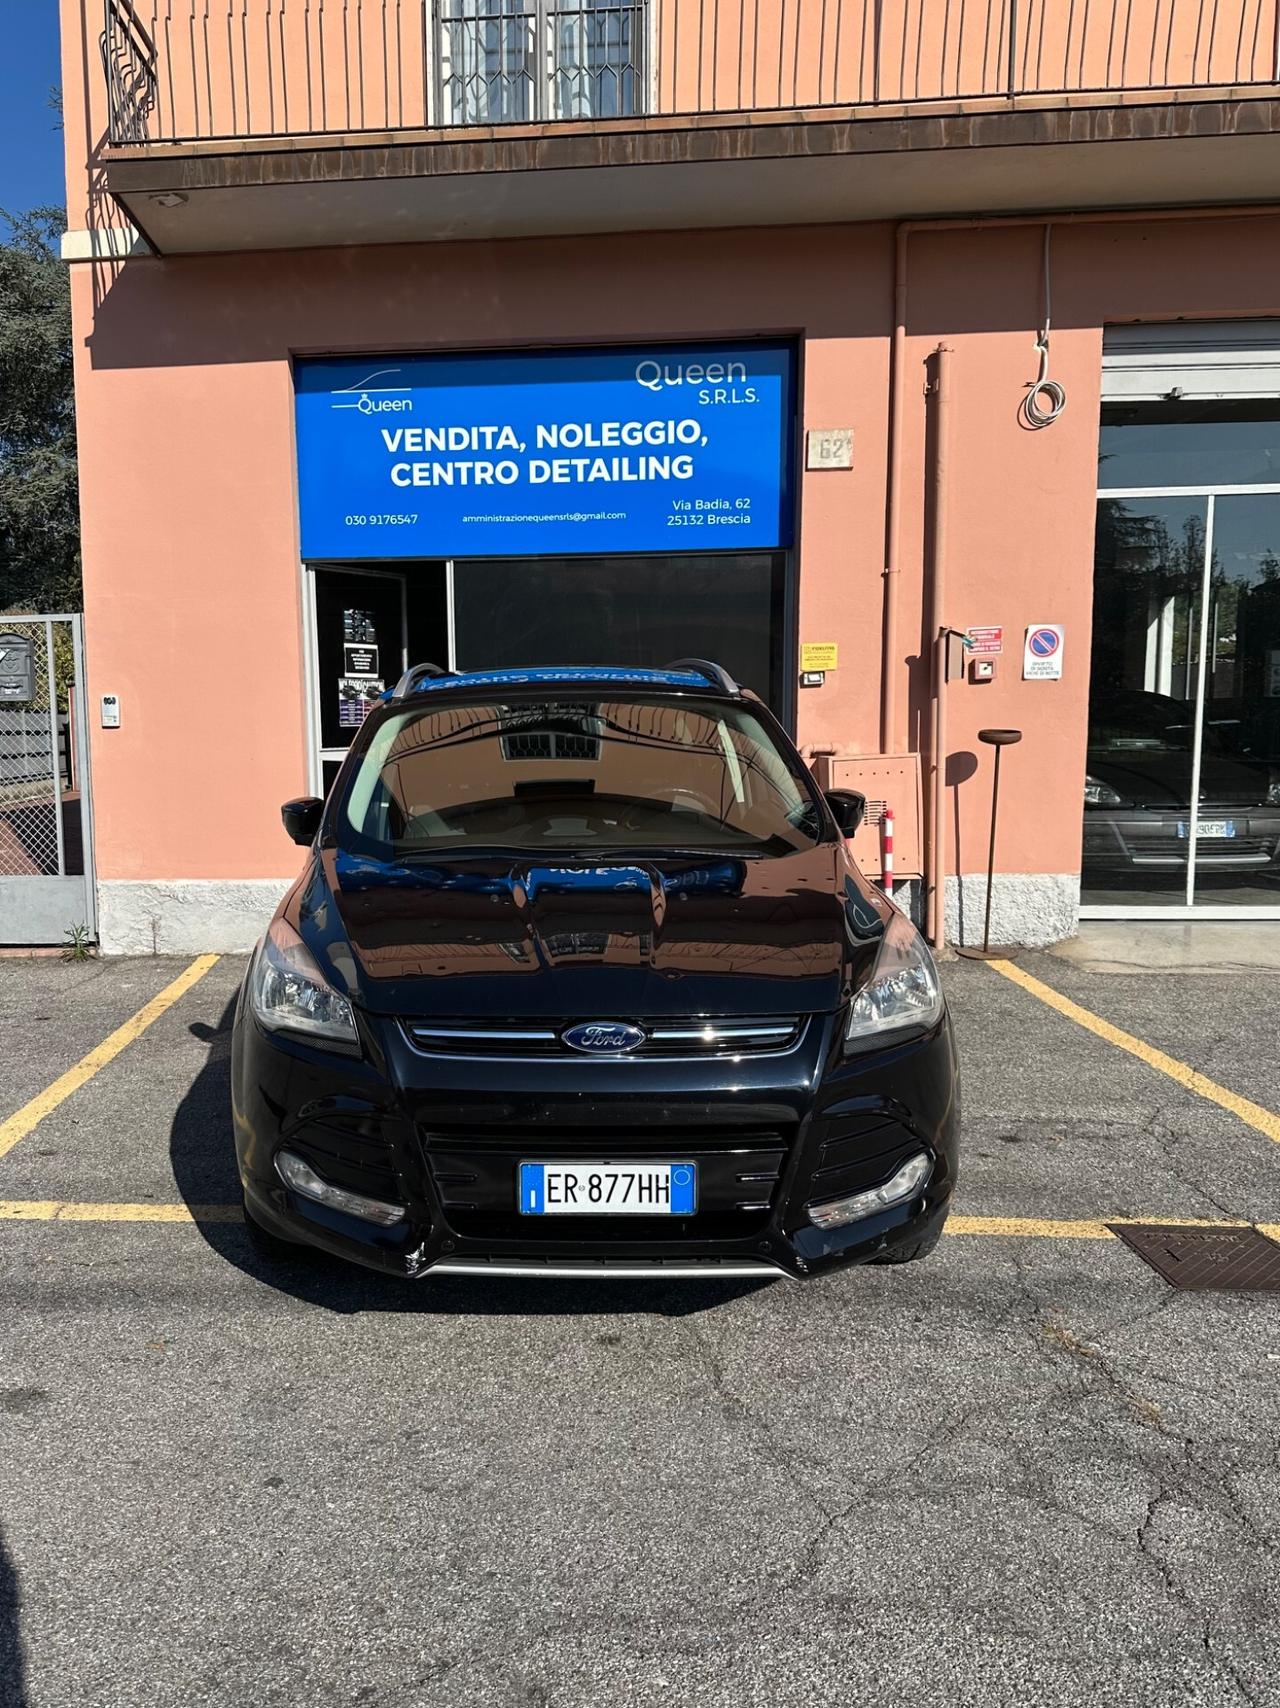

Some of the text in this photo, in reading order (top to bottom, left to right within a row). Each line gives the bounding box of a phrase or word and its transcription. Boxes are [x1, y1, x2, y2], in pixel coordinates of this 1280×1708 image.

[635, 360, 747, 391] Queen
[698, 387, 760, 405] S.R.L.S.
[357, 398, 413, 415] Queen
[381, 419, 708, 453] VENDITA, NOLEGGIO,
[390, 455, 693, 487] CENTRO DETAILING
[672, 498, 751, 512] Via Badia, 62
[345, 514, 418, 526] 030 9176547
[462, 511, 627, 524] amministrazionequeensrls@gmail.com
[667, 513, 751, 526] 25132 Brescia
[581, 1026, 626, 1047] Ford
[547, 1173, 578, 1203] ER
[588, 1173, 670, 1203] 877HH
